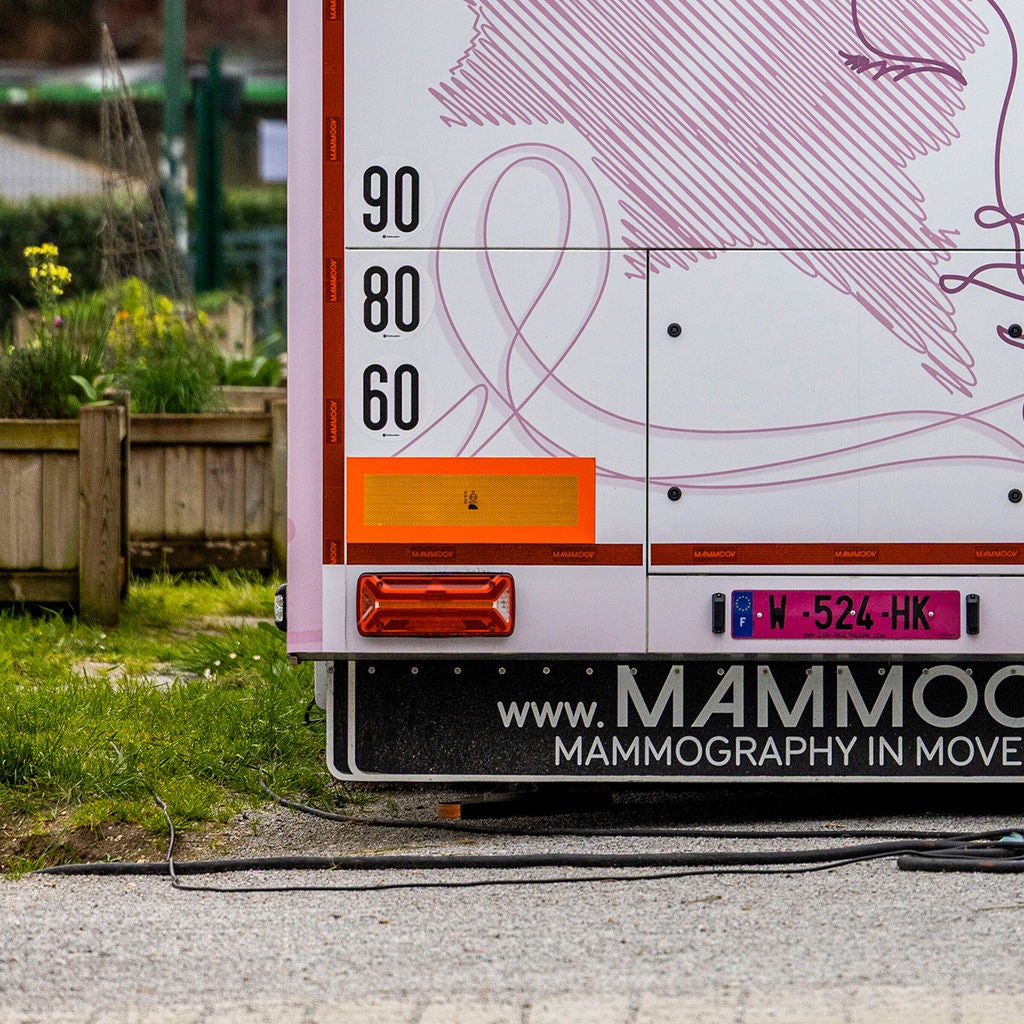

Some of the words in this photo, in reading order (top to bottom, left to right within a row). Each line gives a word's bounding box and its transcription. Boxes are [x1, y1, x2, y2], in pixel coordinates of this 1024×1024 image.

[330, 118, 338, 161] MAMMOOV
[362, 165, 420, 233] 90
[330, 258, 338, 302] MAMMOOV
[363, 265, 420, 333] 80
[363, 363, 420, 431] 60
[330, 400, 338, 443] MAMMOOV
[411, 550, 454, 558] MAMMOOV
[552, 550, 595, 558] MAMMOOV
[693, 550, 736, 558] MAMMOOV
[834, 550, 877, 558] MAMMOOV
[975, 550, 1018, 558] MAMMOOV
[739, 617, 747, 628] F
[554, 735, 858, 767] MAMMOGRAPHY
[868, 735, 903, 766] IN
